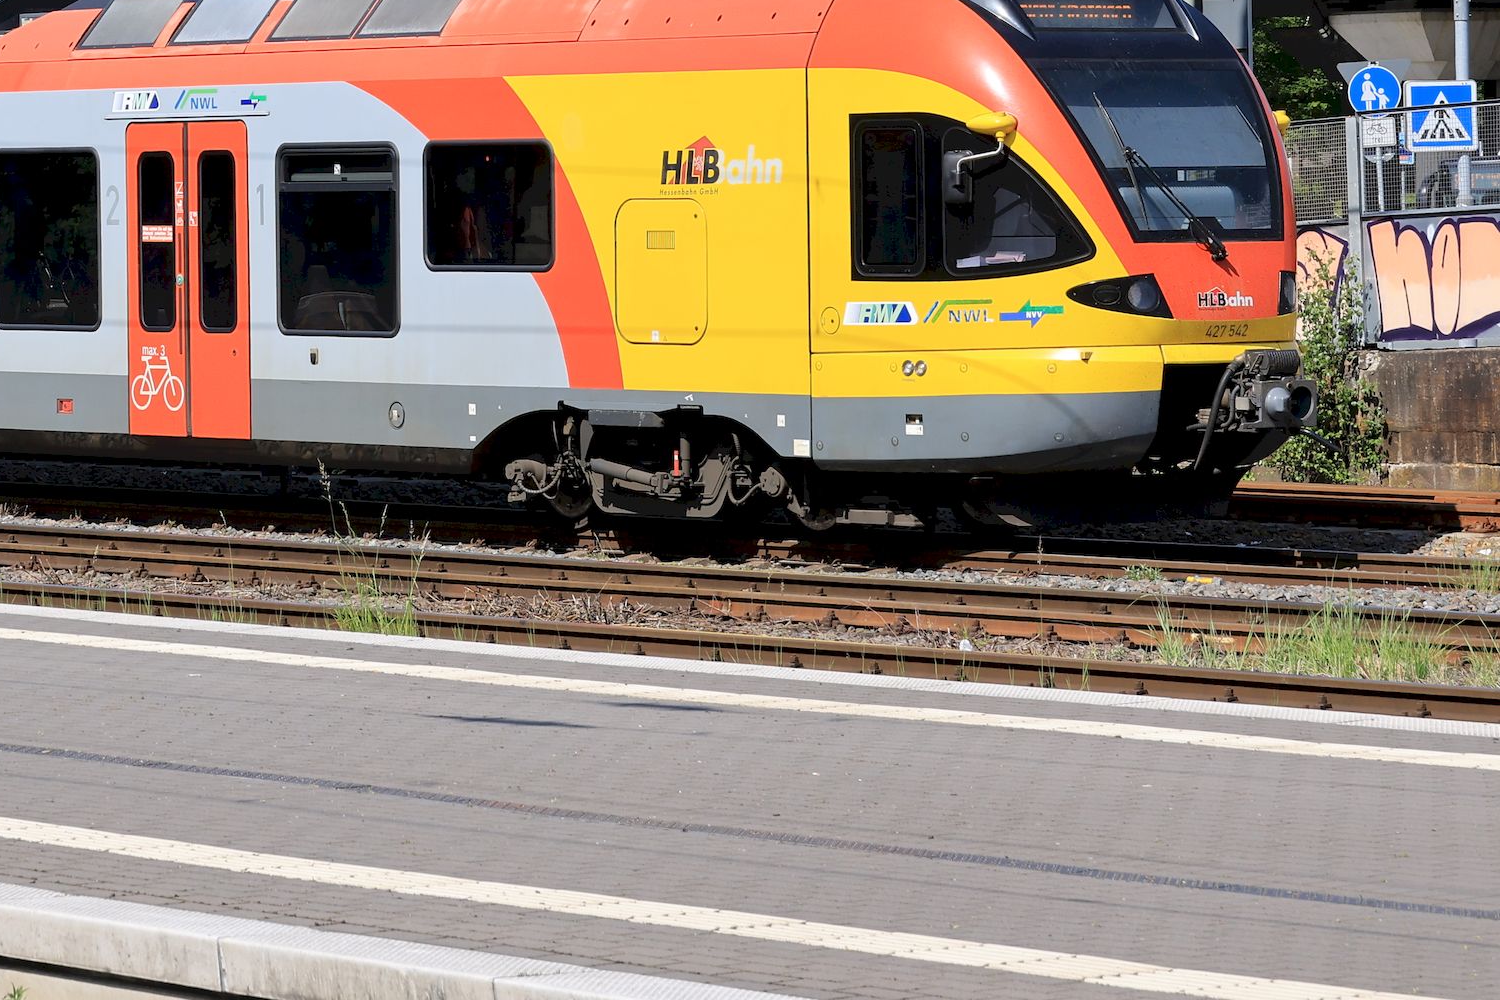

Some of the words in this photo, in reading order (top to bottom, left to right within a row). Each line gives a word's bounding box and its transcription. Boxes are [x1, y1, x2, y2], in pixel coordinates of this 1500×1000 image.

[190, 97, 218, 110] NWL
[106, 184, 120, 226] 2
[256, 183, 265, 226] 1
[948, 309, 994, 323] NWL
[1025, 311, 1043, 319] NVV
[1205, 325, 1227, 338] 427
[1228, 324, 1249, 337] 542
[141, 346, 159, 356] max.
[160, 345, 166, 356] 3
